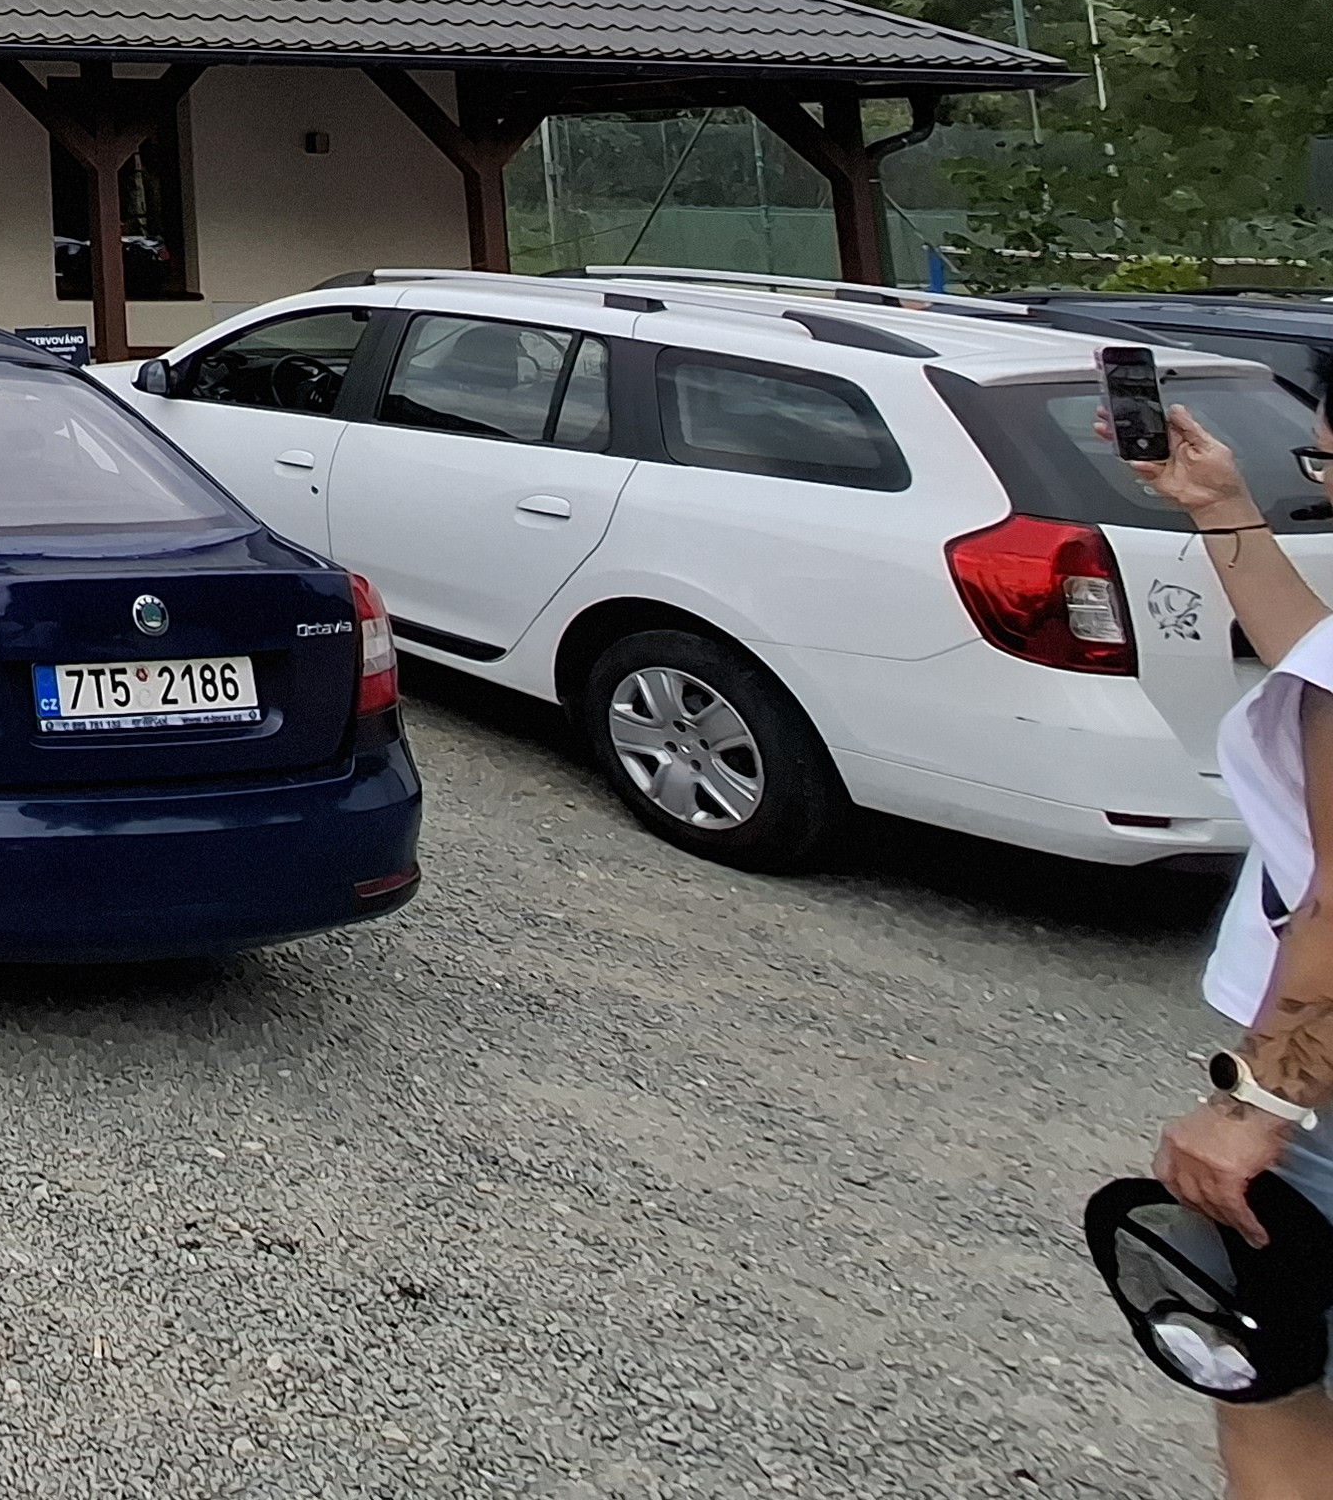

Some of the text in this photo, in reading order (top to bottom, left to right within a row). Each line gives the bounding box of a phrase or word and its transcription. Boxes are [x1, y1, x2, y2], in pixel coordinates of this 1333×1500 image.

[296, 619, 353, 637] Octavia
[65, 663, 239, 710] 7T5 2186
[41, 698, 58, 711] CZ
